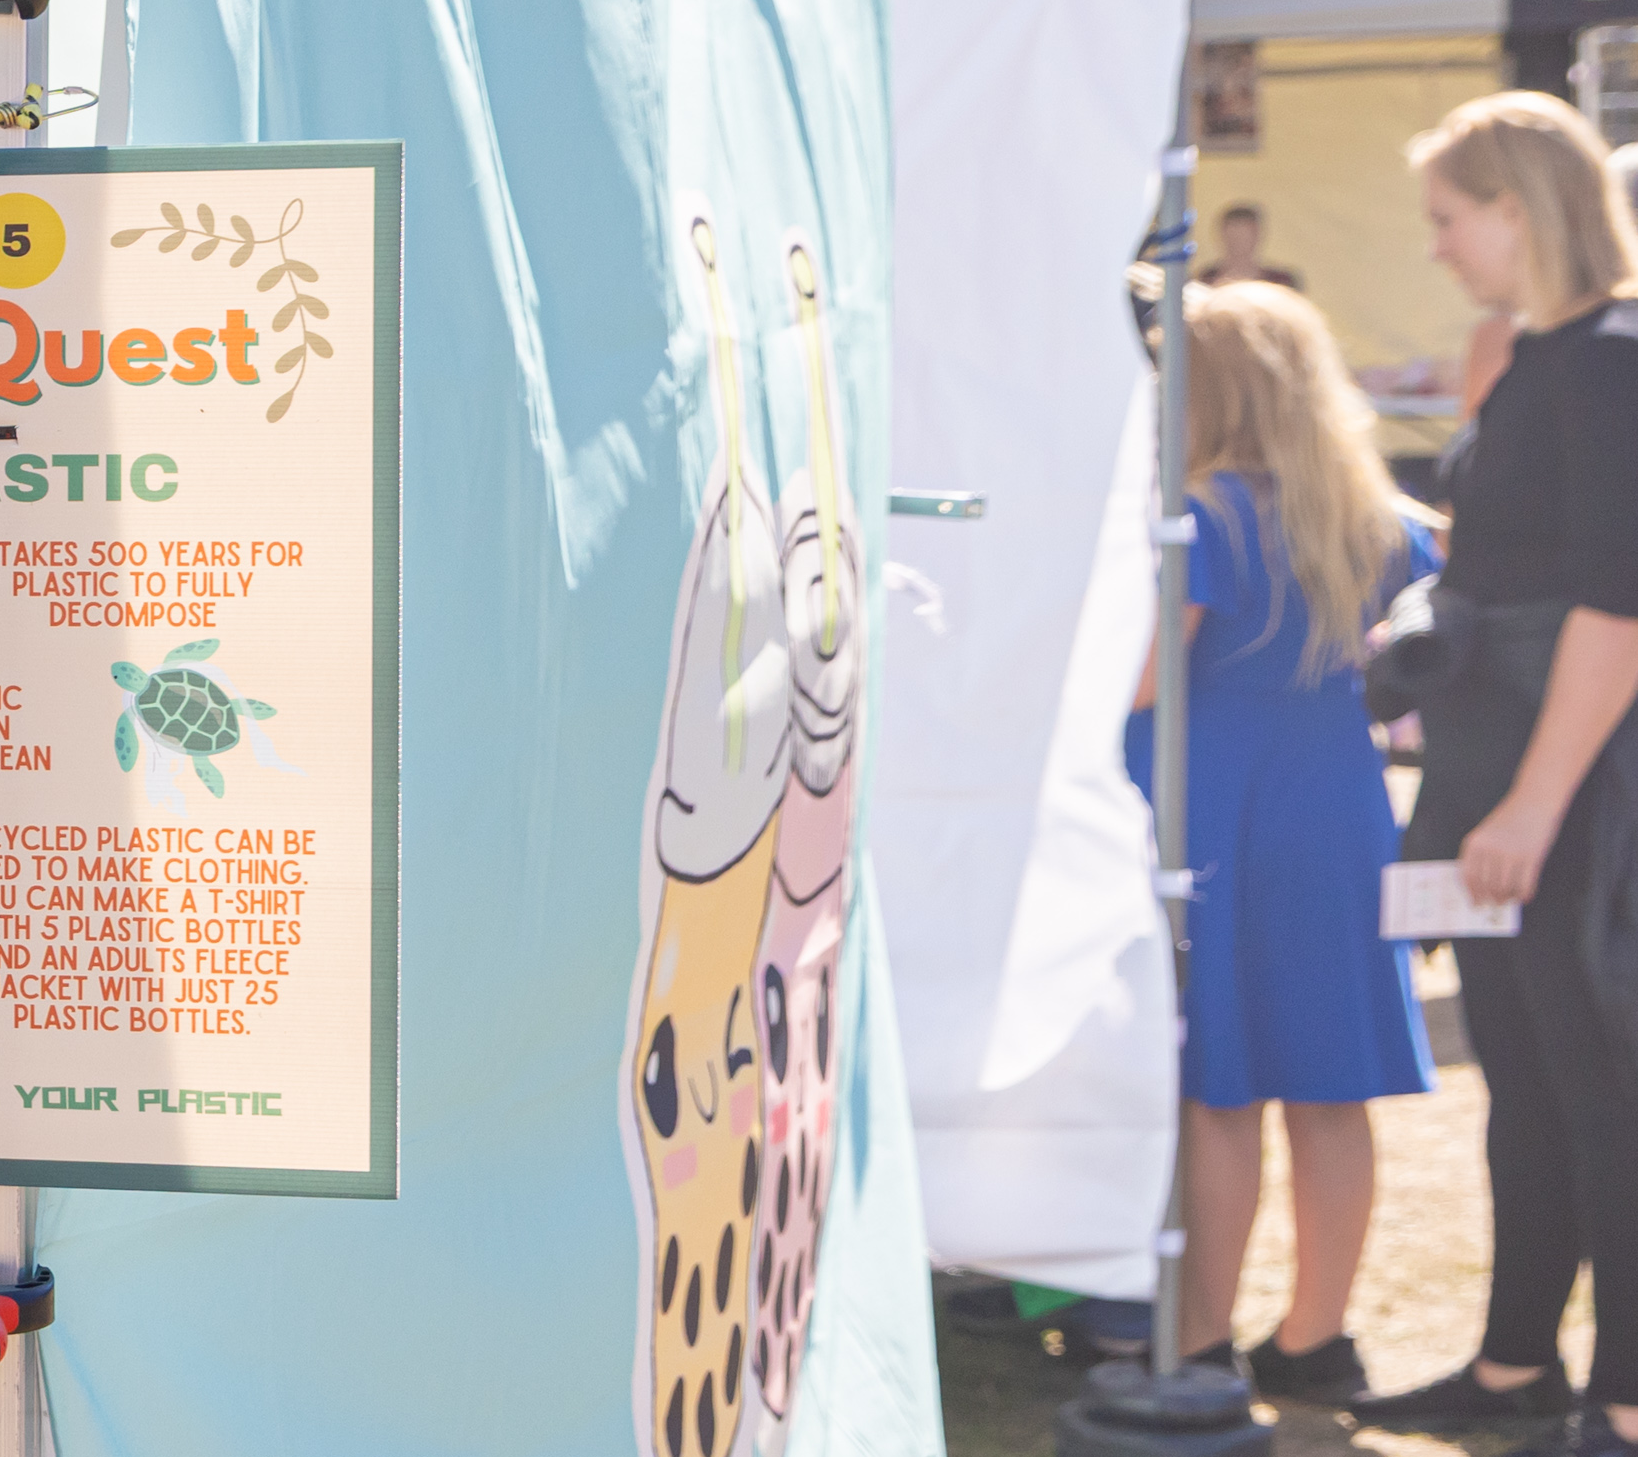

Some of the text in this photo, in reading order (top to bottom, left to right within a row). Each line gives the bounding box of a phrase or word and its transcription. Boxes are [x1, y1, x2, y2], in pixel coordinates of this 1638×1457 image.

[1, 223, 32, 258] 5
[88, 541, 149, 568] 500
[158, 541, 242, 568] YEARS
[251, 541, 304, 568] FOR
[12, 572, 254, 598] PLASTIC TO FULLY
[48, 602, 217, 628] DECOMPOSE
[97, 826, 204, 854] PLASTIC
[214, 828, 276, 855] CAN
[284, 829, 316, 856] BE
[14, 1085, 119, 1111] YOUR
[137, 1088, 282, 1116] PLASTIC
